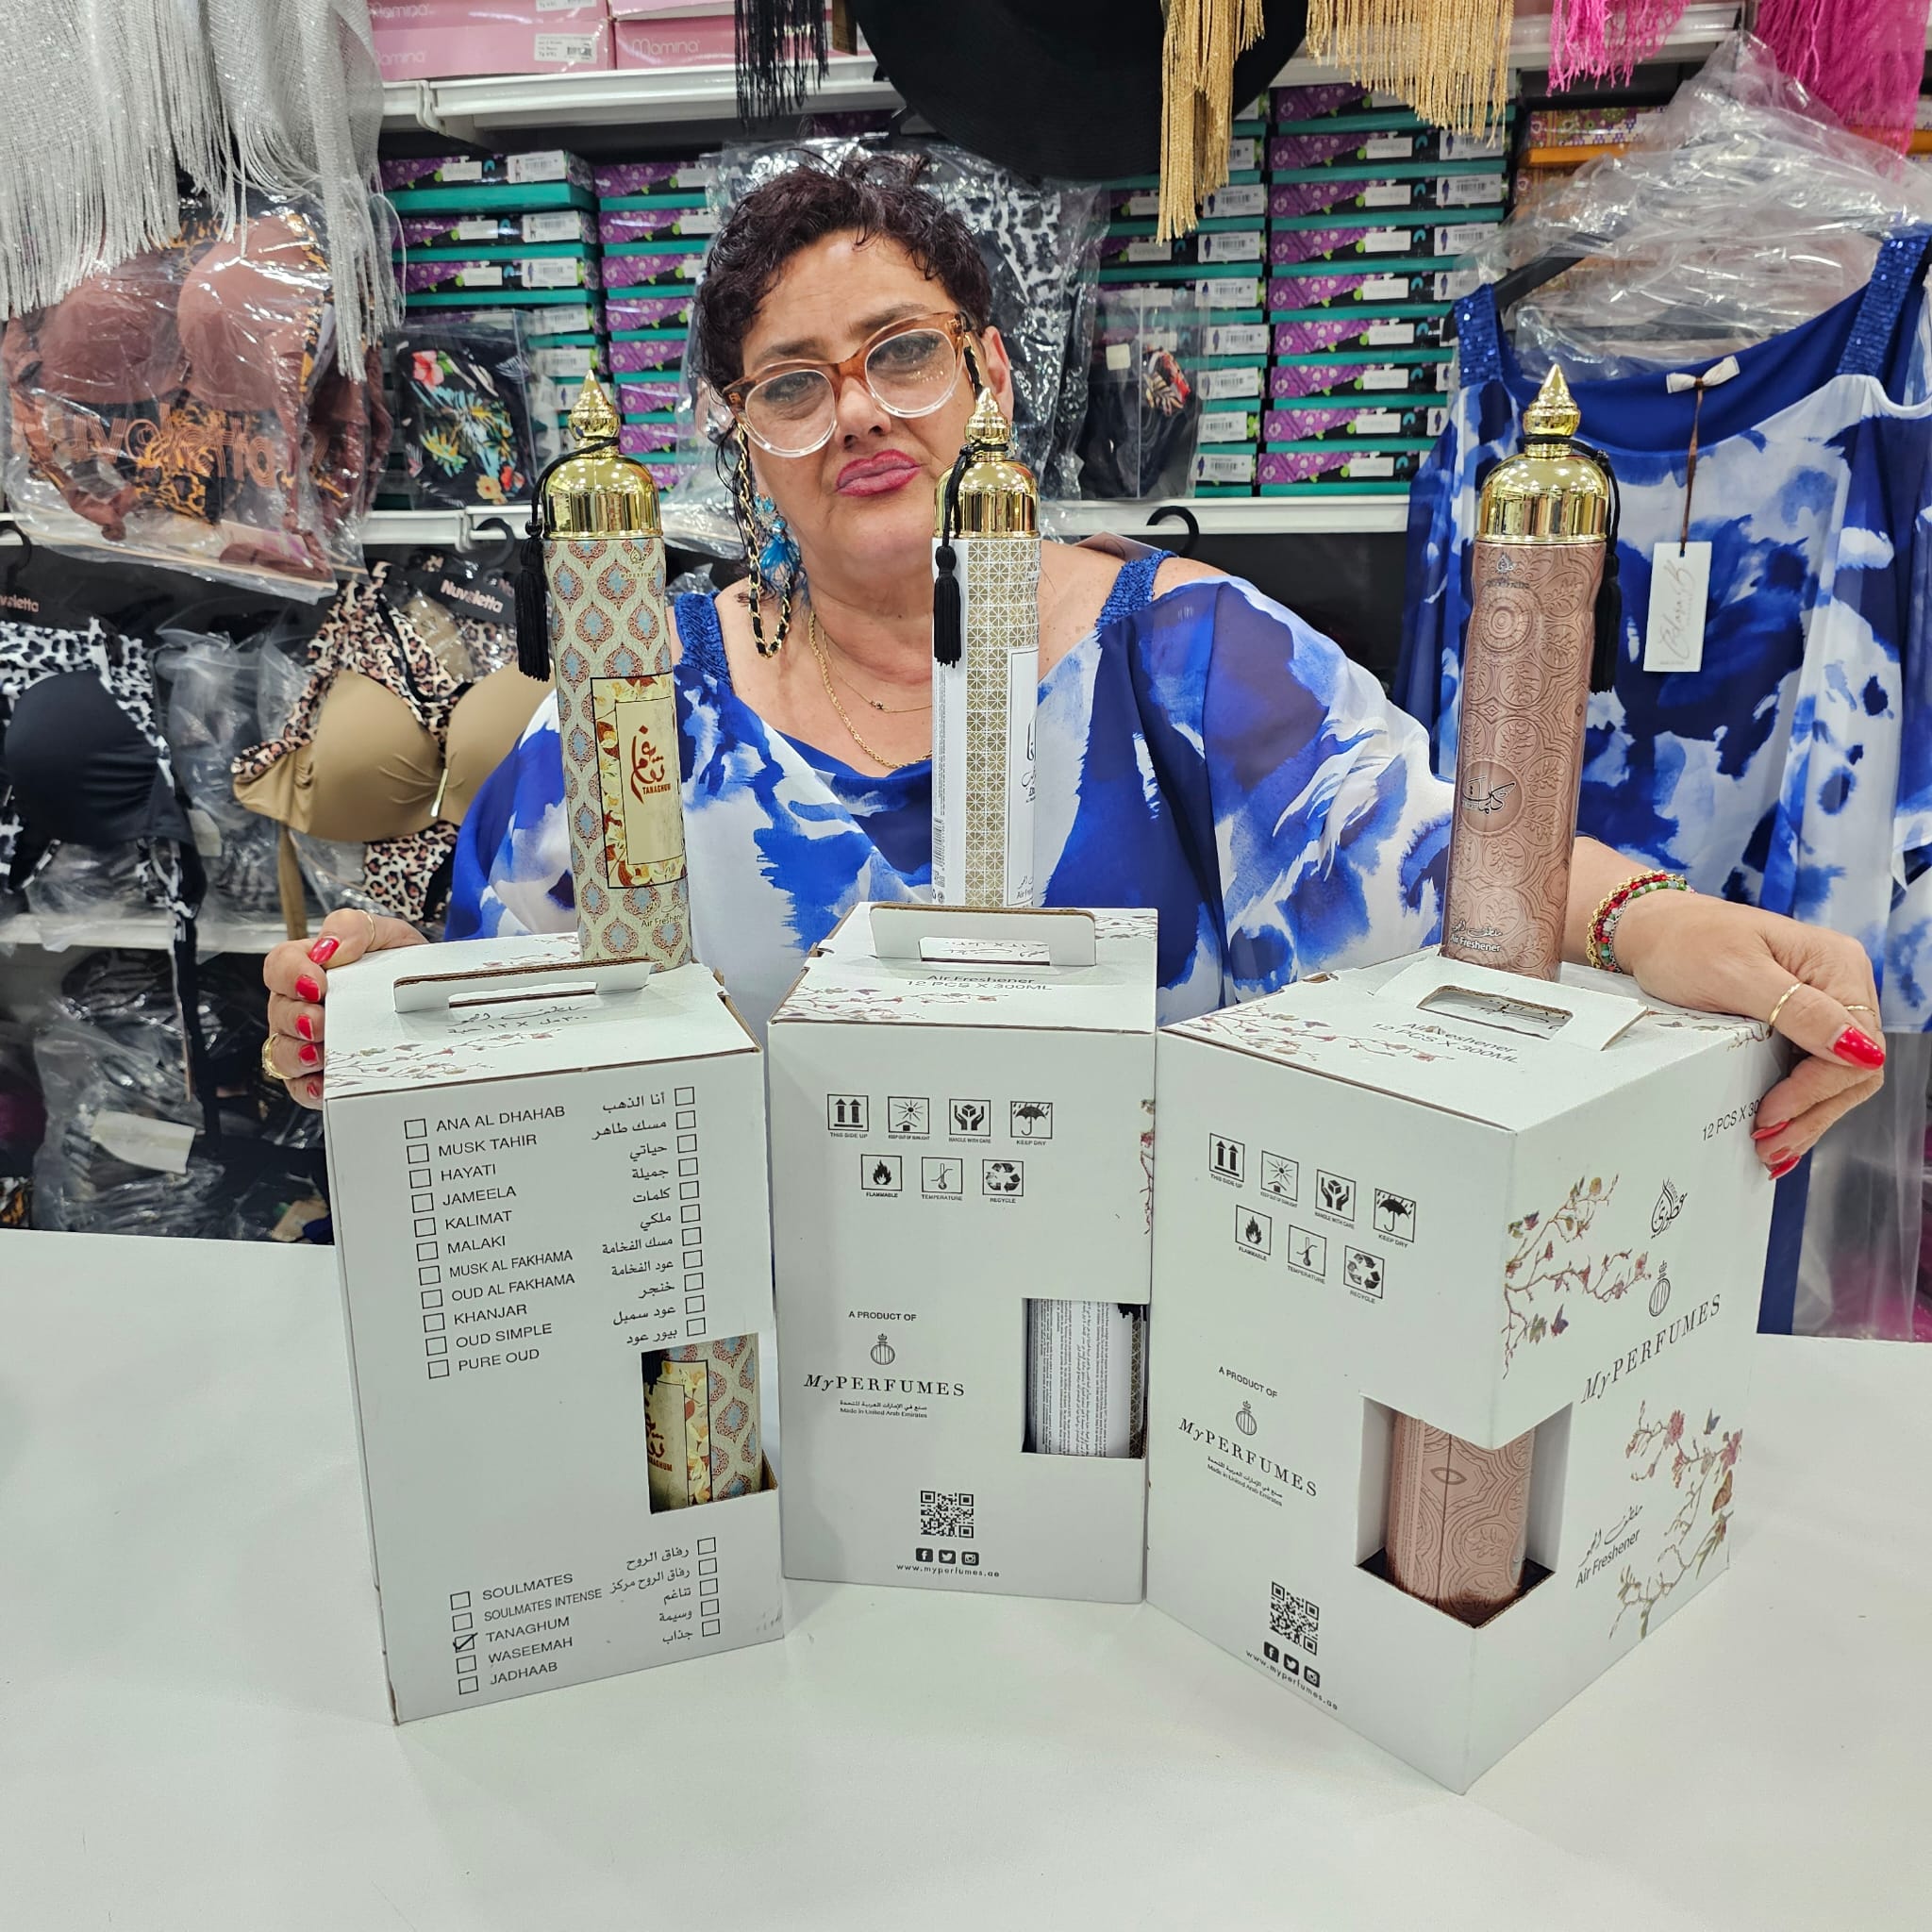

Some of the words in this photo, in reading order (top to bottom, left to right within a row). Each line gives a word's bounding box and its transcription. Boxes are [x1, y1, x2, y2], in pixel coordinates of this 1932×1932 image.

[1459, 936, 1502, 952] Freshener
[1395, 1029, 1439, 1042] PCS
[1457, 1045, 1518, 1063] 300ML
[603, 1096, 643, 1113] الذهب
[651, 1092, 664, 1105] أنا
[437, 1118, 470, 1132] ANA
[475, 1115, 494, 1127] AL
[500, 1107, 565, 1124] DHAHAB
[633, 1120, 666, 1131] مسك
[1703, 1123, 1714, 1141] 12
[1716, 1110, 1737, 1134] PCS
[1739, 1104, 1746, 1123] X
[591, 1123, 627, 1140] طاهر
[439, 1141, 485, 1157] MUSK
[490, 1134, 537, 1149] TAHIR
[630, 1143, 667, 1161] حياتي
[441, 1164, 495, 1181] HAYATI
[632, 1168, 668, 1180] جميلة
[442, 1186, 516, 1206] JAMEELA
[633, 1188, 671, 1203] كلمات
[445, 1210, 511, 1229] KALIMAT
[641, 1212, 671, 1231] ملكي
[448, 1236, 505, 1254] MALAKI
[603, 1239, 641, 1254] الفخامة
[645, 1238, 673, 1247] مسك
[450, 1262, 488, 1277] MUSK
[491, 1260, 508, 1272] AL
[511, 1250, 573, 1268] FAKHAMA
[611, 1260, 650, 1275] الفخامة
[656, 1261, 674, 1273] عود
[452, 1288, 483, 1301] OUD
[488, 1284, 505, 1296] AL
[509, 1274, 575, 1292] FAKHAMA
[639, 1282, 675, 1298] خنجر
[455, 1305, 526, 1324] KHANJAR
[654, 1307, 675, 1318] عود
[858, 1311, 901, 1320] PRODUCT
[457, 1334, 491, 1347] OUD
[496, 1324, 552, 1341] SIMPLE
[627, 1335, 648, 1345] عود
[653, 1330, 677, 1341] بيور
[459, 1355, 501, 1371] PURE
[506, 1349, 539, 1362] OUD
[1219, 1366, 1224, 1374] A
[1226, 1369, 1264, 1392] PRODUCT
[1266, 1389, 1277, 1398] OF
[626, 1551, 657, 1571] الروح
[662, 1547, 689, 1561] رفاق
[1575, 1563, 1591, 1589] Air
[1591, 1528, 1641, 1575] Freshener
[639, 1571, 663, 1590] الروح
[668, 1568, 690, 1581] رفاق
[483, 1574, 574, 1600] SOULMATES
[610, 1579, 635, 1593] مركز
[484, 1599, 552, 1622] SOULMATES
[555, 1589, 602, 1607] INTENSE
[664, 1588, 691, 1606] تناغم
[659, 1610, 691, 1622] وسيمة
[487, 1617, 570, 1642] TANAGHUM
[663, 1630, 692, 1644] جذاب
[489, 1637, 573, 1663] WASEEMAH
[490, 1661, 558, 1685] JADHAAB
